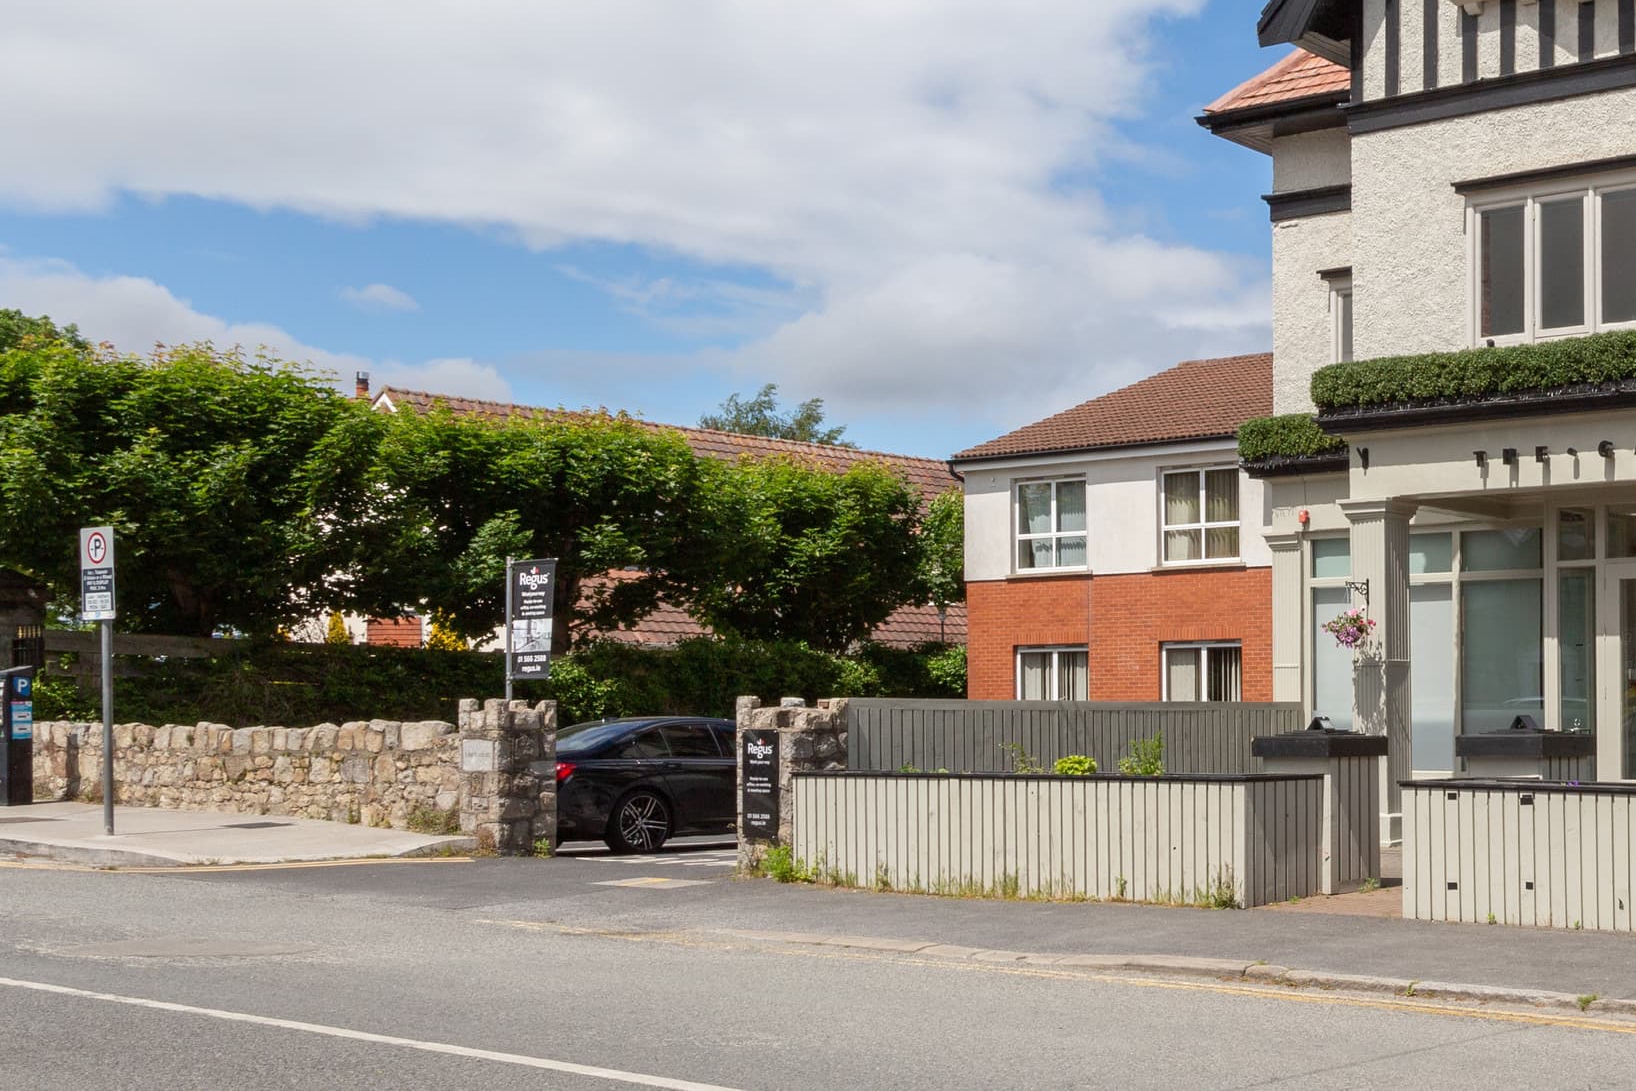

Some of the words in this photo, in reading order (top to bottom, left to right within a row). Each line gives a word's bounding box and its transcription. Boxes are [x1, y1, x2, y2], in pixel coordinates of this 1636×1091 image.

[520, 572, 549, 590] Regus
[18, 679, 28, 693] P
[747, 743, 773, 759] Regus
